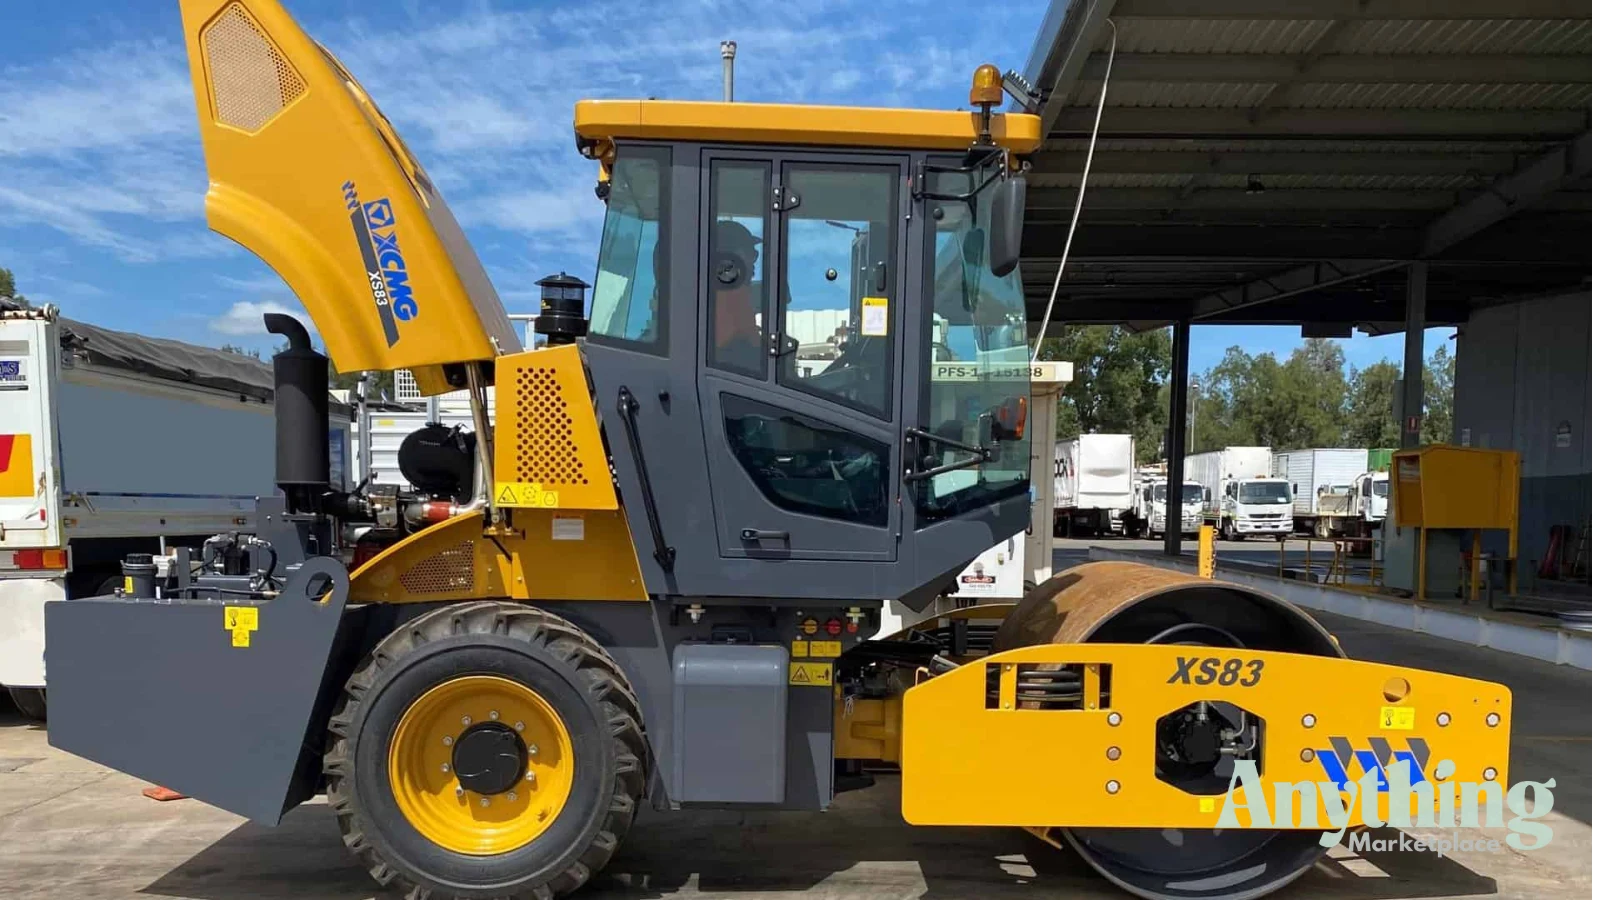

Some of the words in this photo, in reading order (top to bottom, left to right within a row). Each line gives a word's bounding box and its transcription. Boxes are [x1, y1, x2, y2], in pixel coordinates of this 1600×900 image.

[368, 271, 388, 306] XS83
[371, 230, 418, 321] XCMG
[1166, 657, 1264, 687] XS83
